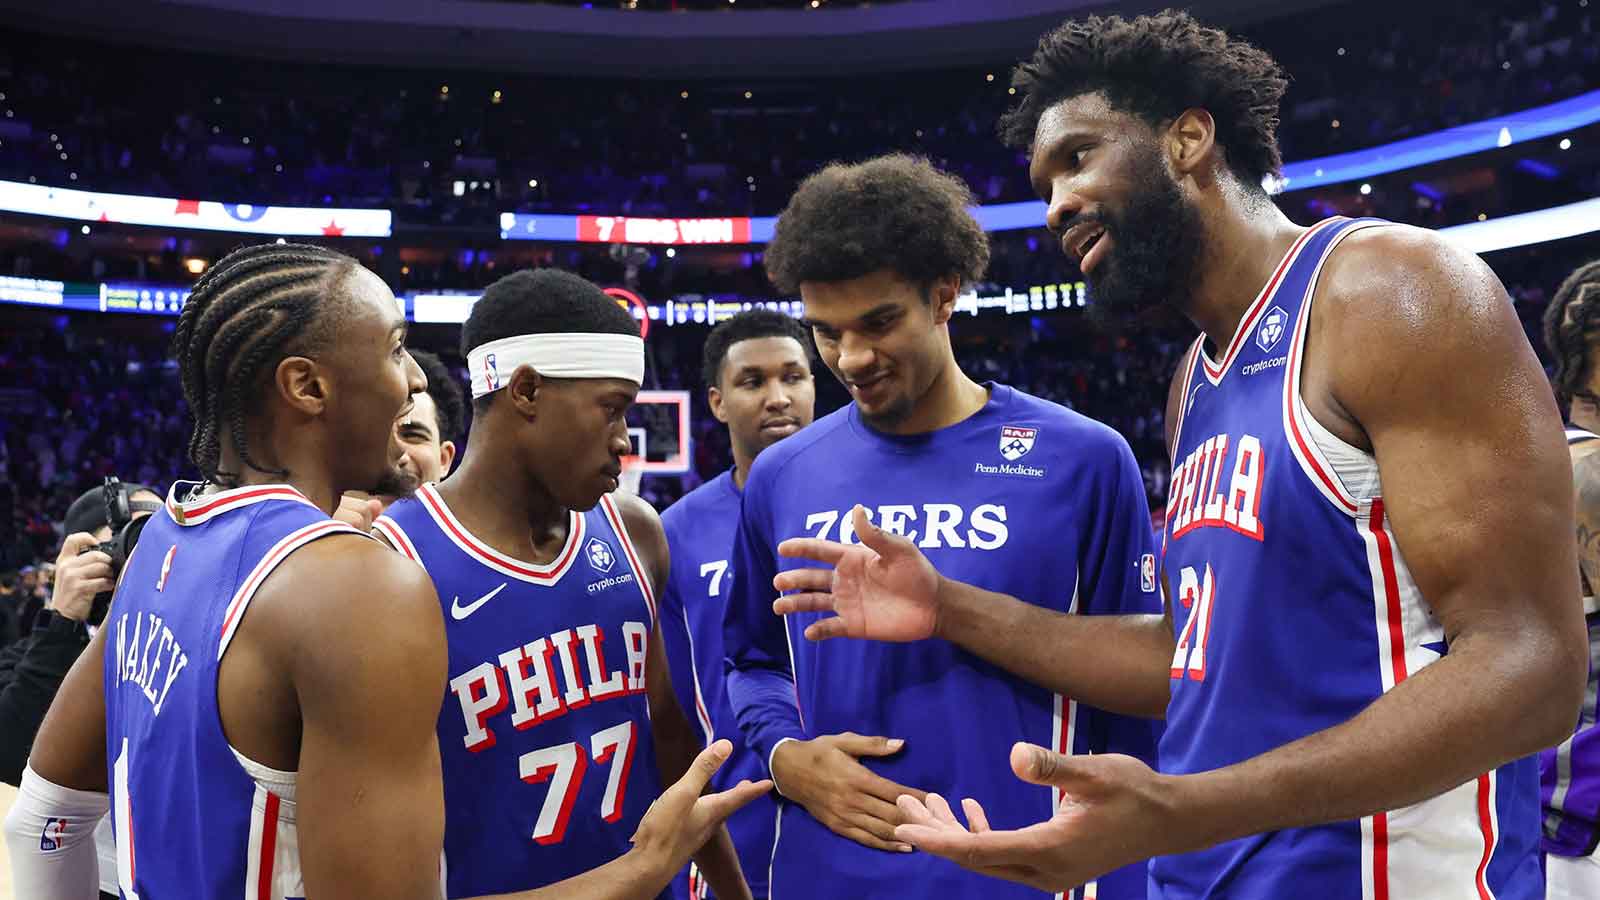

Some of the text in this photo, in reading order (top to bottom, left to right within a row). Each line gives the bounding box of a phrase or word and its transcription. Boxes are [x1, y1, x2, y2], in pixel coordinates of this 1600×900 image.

[1242, 356, 1286, 375] crypto.com
[975, 463, 1044, 476] Penn Medicine
[1166, 434, 1264, 541] PHILA
[588, 574, 632, 592] crypto.com
[1170, 562, 1215, 682] 21
[116, 611, 188, 716] MAXEY
[450, 621, 648, 752] PHILA
[519, 721, 638, 846] 77
